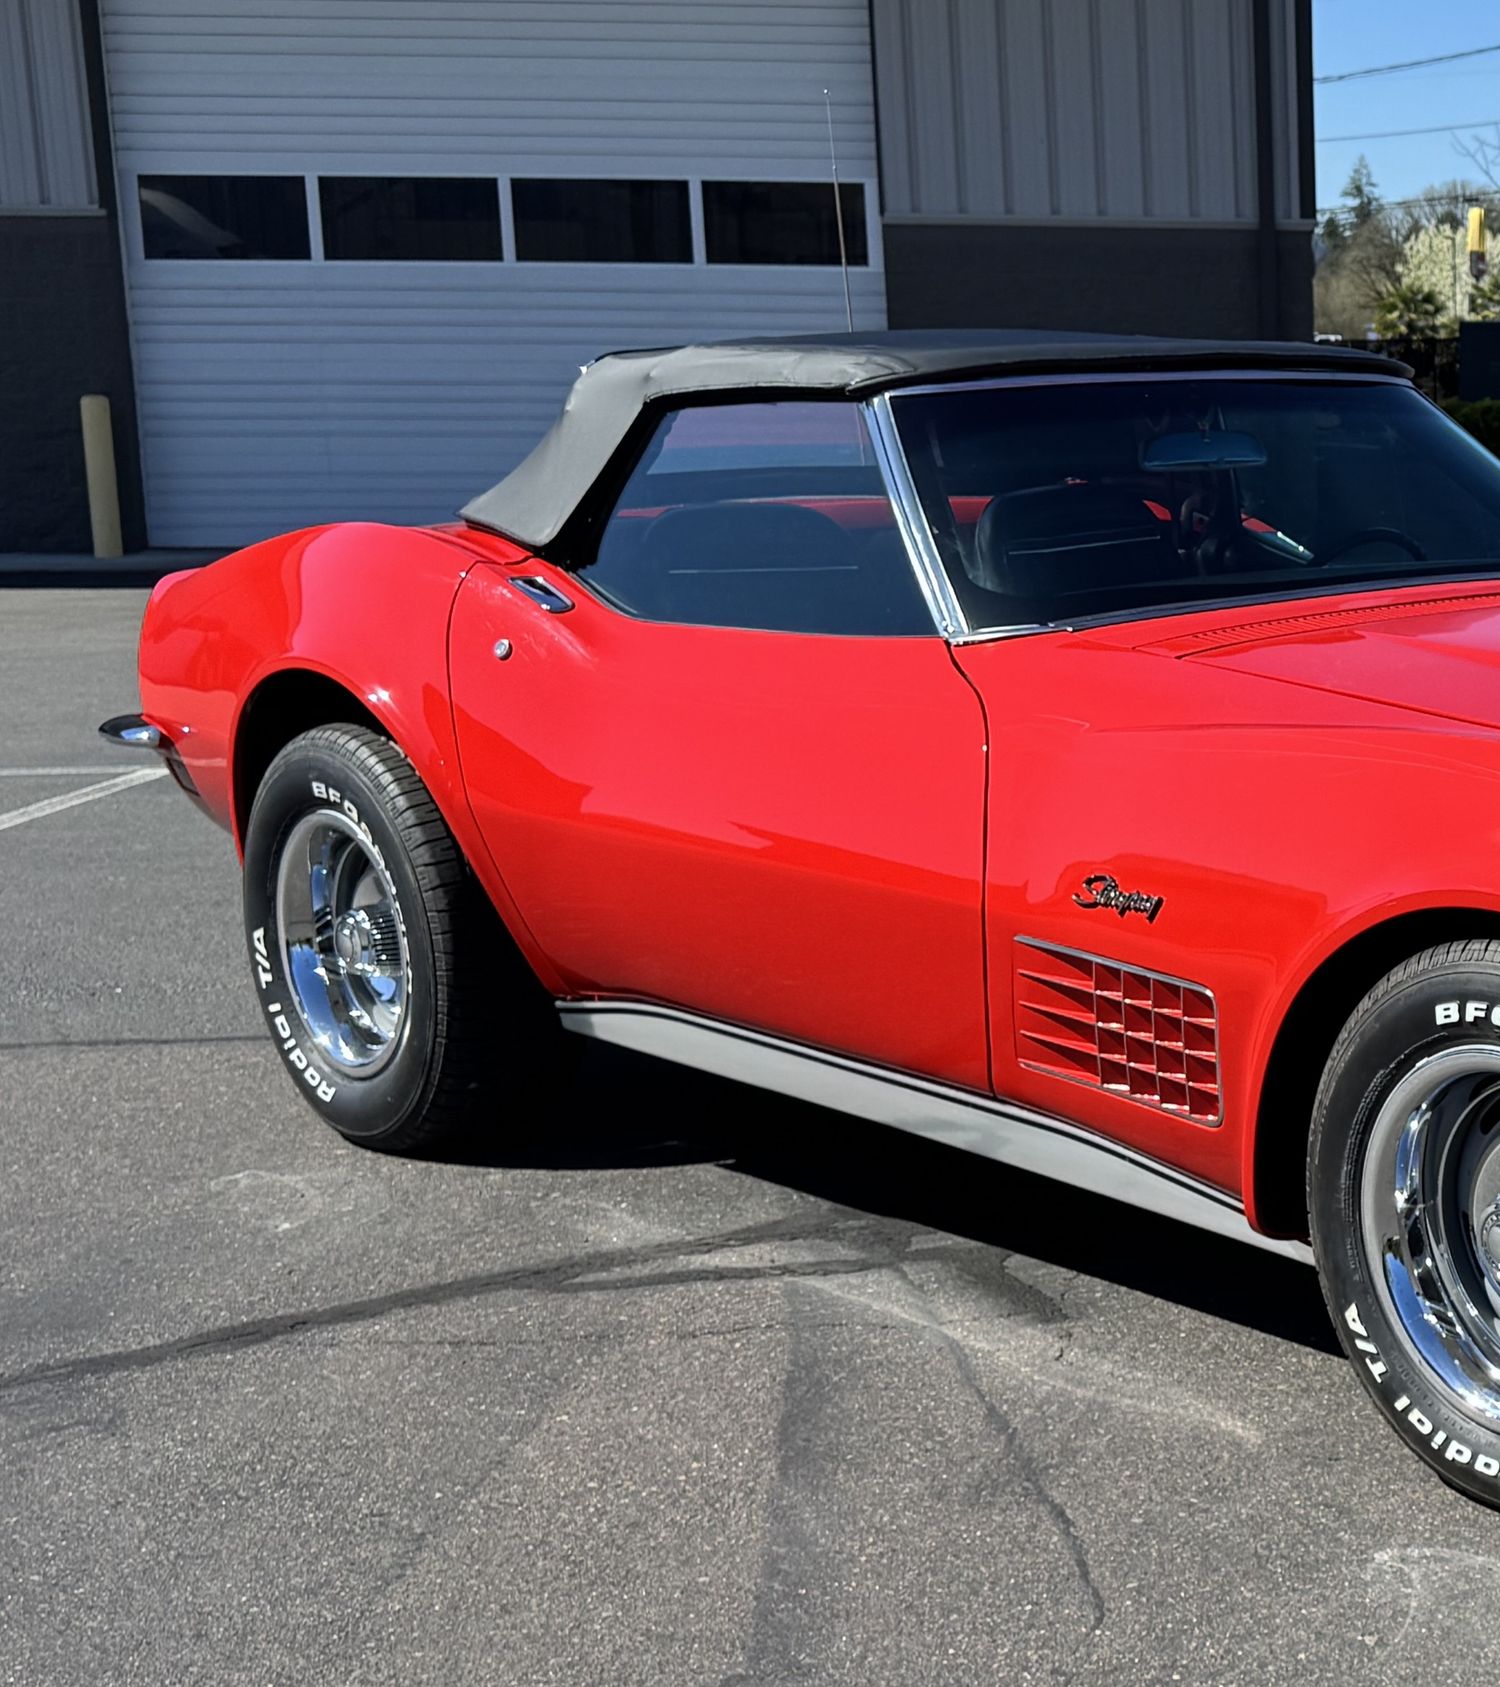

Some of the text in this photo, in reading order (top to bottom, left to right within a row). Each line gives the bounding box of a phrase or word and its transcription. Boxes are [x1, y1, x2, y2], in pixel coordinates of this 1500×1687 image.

[252, 927, 336, 1103] Radial T/A
[1343, 1302, 1389, 1384] T/A
